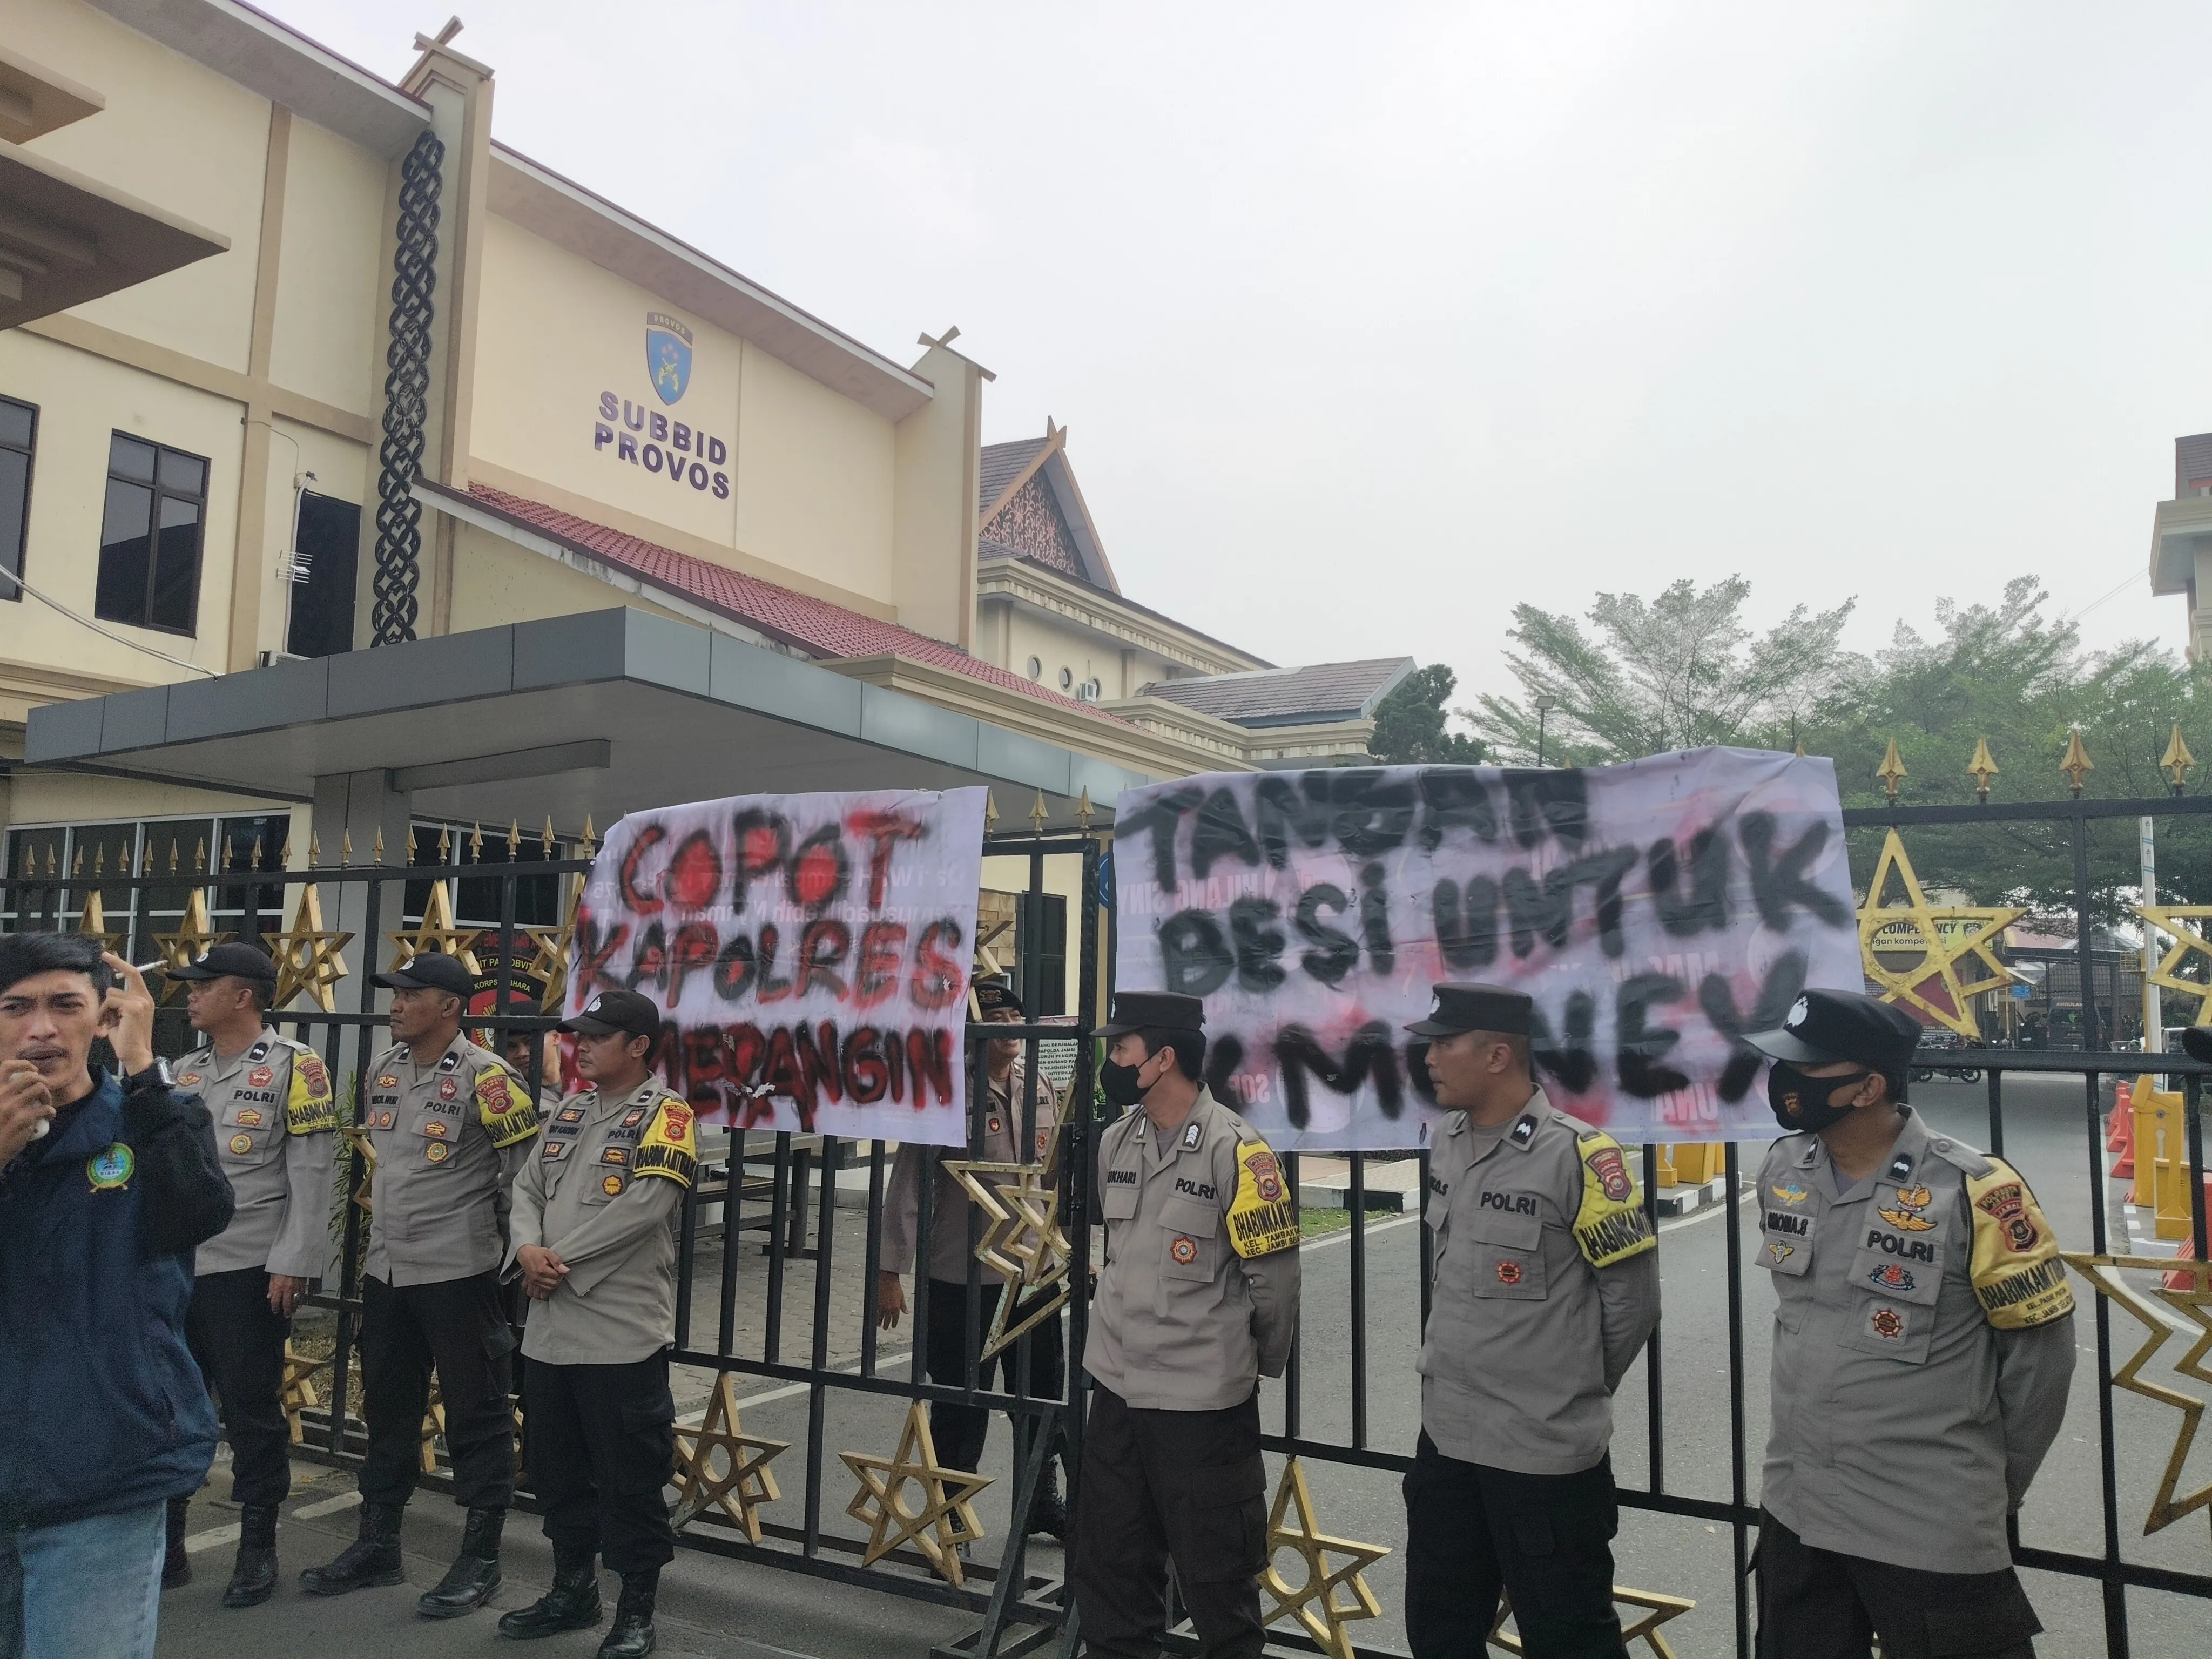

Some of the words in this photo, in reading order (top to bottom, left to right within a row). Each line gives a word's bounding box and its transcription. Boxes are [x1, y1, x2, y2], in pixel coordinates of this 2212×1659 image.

[654, 315, 685, 335] PROVOS
[599, 390, 726, 466] SUBBID
[594, 421, 729, 500] PROVOS
[619, 806, 930, 917] COPOT
[1432, 808, 1854, 969] UNTUK
[1882, 923, 1957, 934] COMPENCY
[574, 912, 964, 1011] KAPOLRES
[474, 979, 498, 990] KORPS
[234, 1090, 275, 1103] POLRI
[424, 1101, 461, 1116] POLRI
[1107, 1170, 1136, 1184] UKHARI
[1175, 1177, 1215, 1199] POLRI
[1480, 1191, 1536, 1216] POLRI
[1244, 1239, 1263, 1249] KEL.
[1245, 1246, 1264, 1256] KEC.
[1266, 1239, 1287, 1251] JAMBI
[1867, 1230, 1934, 1263] POLRI
